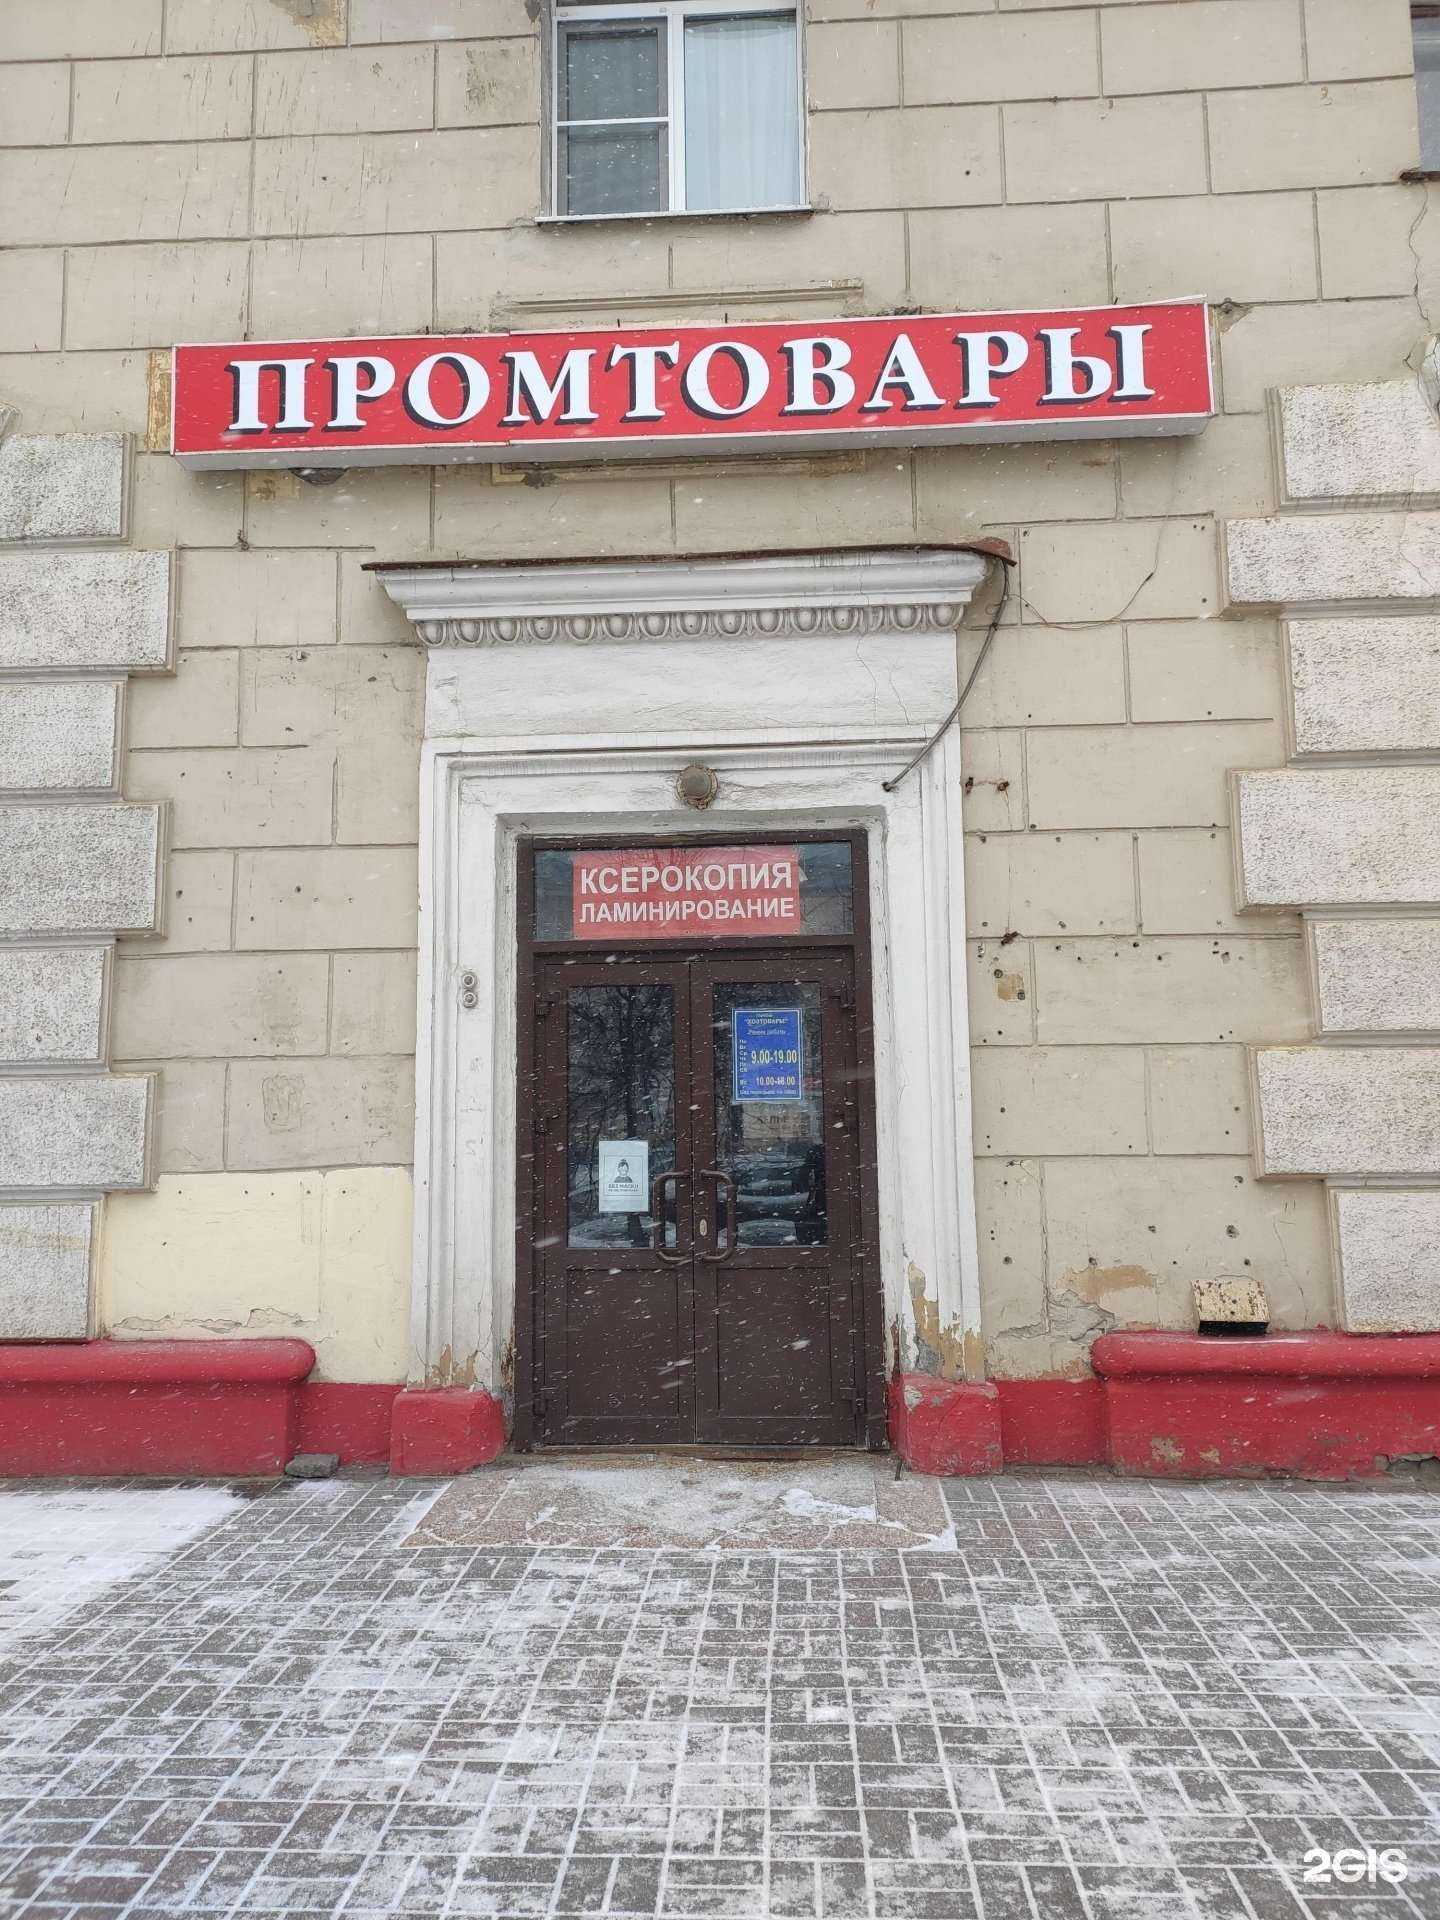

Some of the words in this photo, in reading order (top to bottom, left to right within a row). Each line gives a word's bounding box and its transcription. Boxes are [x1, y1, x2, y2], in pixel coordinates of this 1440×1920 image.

[226, 324, 1158, 435] ПРОМТОВАРЫ
[580, 862, 793, 895] КСЕРОКОПИЯ
[578, 897, 795, 924] ЛАМИНИРОВАНИЕ
[751, 1049, 798, 1065] 9.00-19.00
